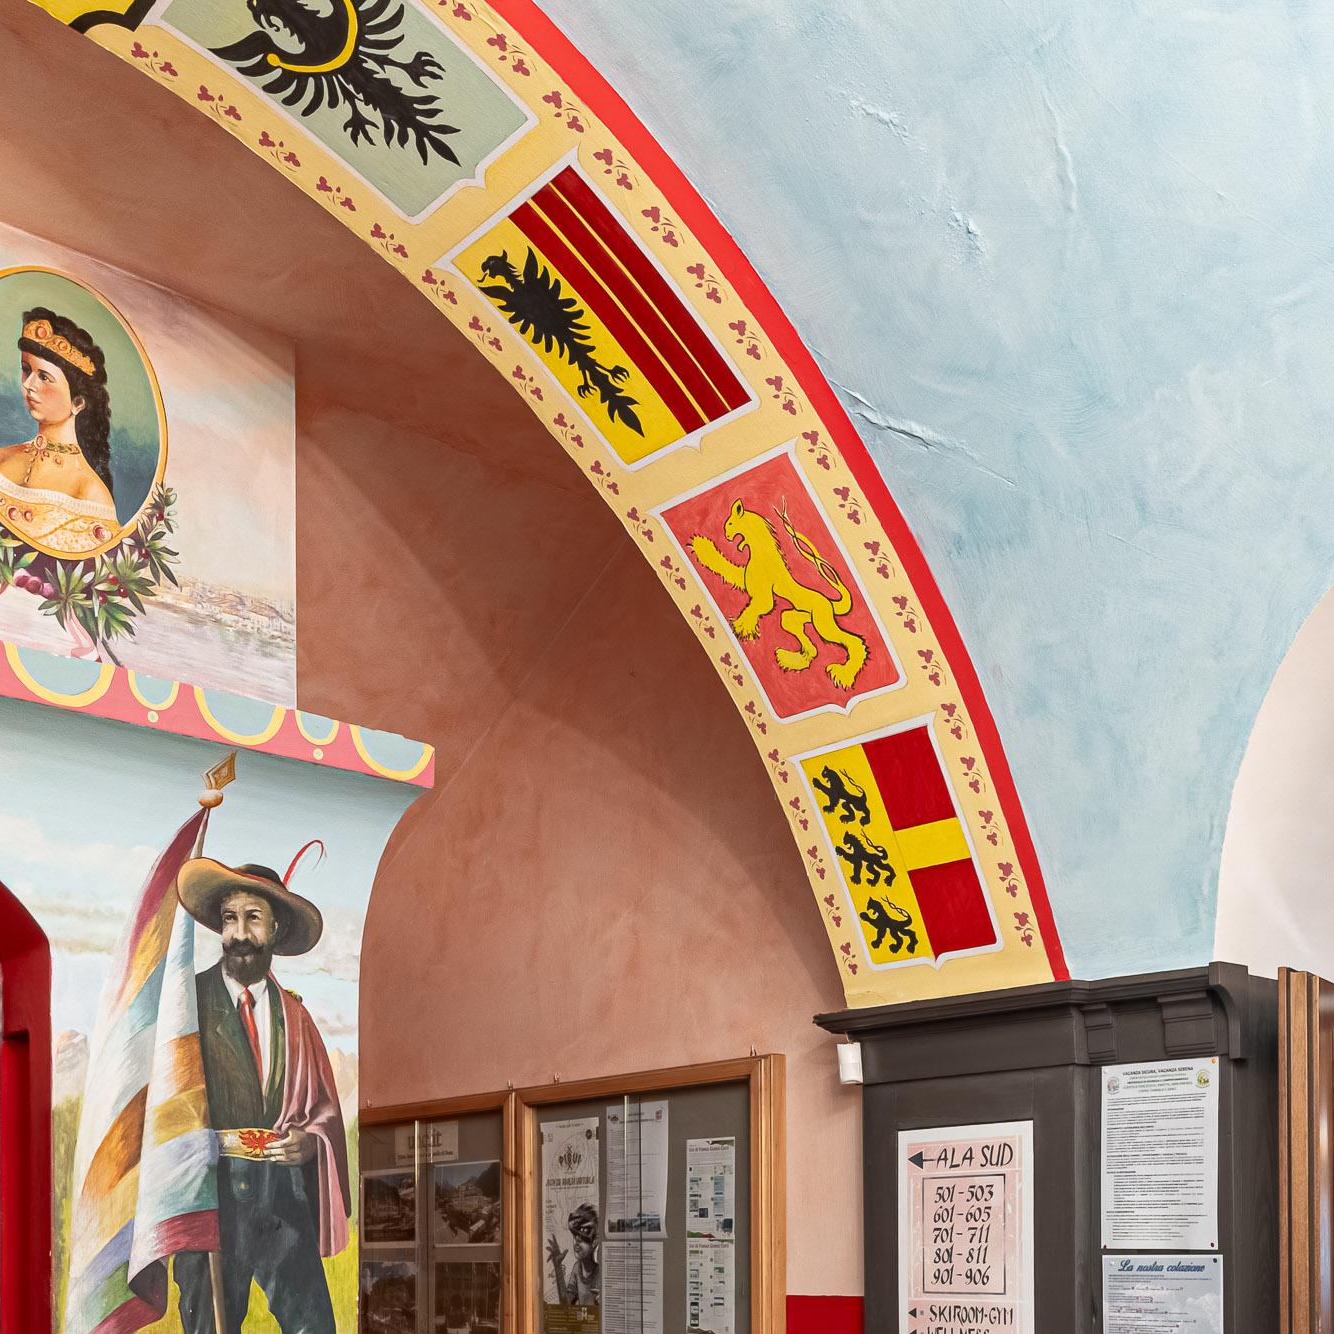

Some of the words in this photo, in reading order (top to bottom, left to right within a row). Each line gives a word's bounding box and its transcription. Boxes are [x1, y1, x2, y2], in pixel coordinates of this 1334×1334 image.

[936, 1146, 974, 1169] ALA
[980, 1142, 1014, 1168] SUD
[1118, 1259, 1134, 1272] La
[1136, 1261, 1164, 1272] nostra
[1166, 1260, 1206, 1272] colazione
